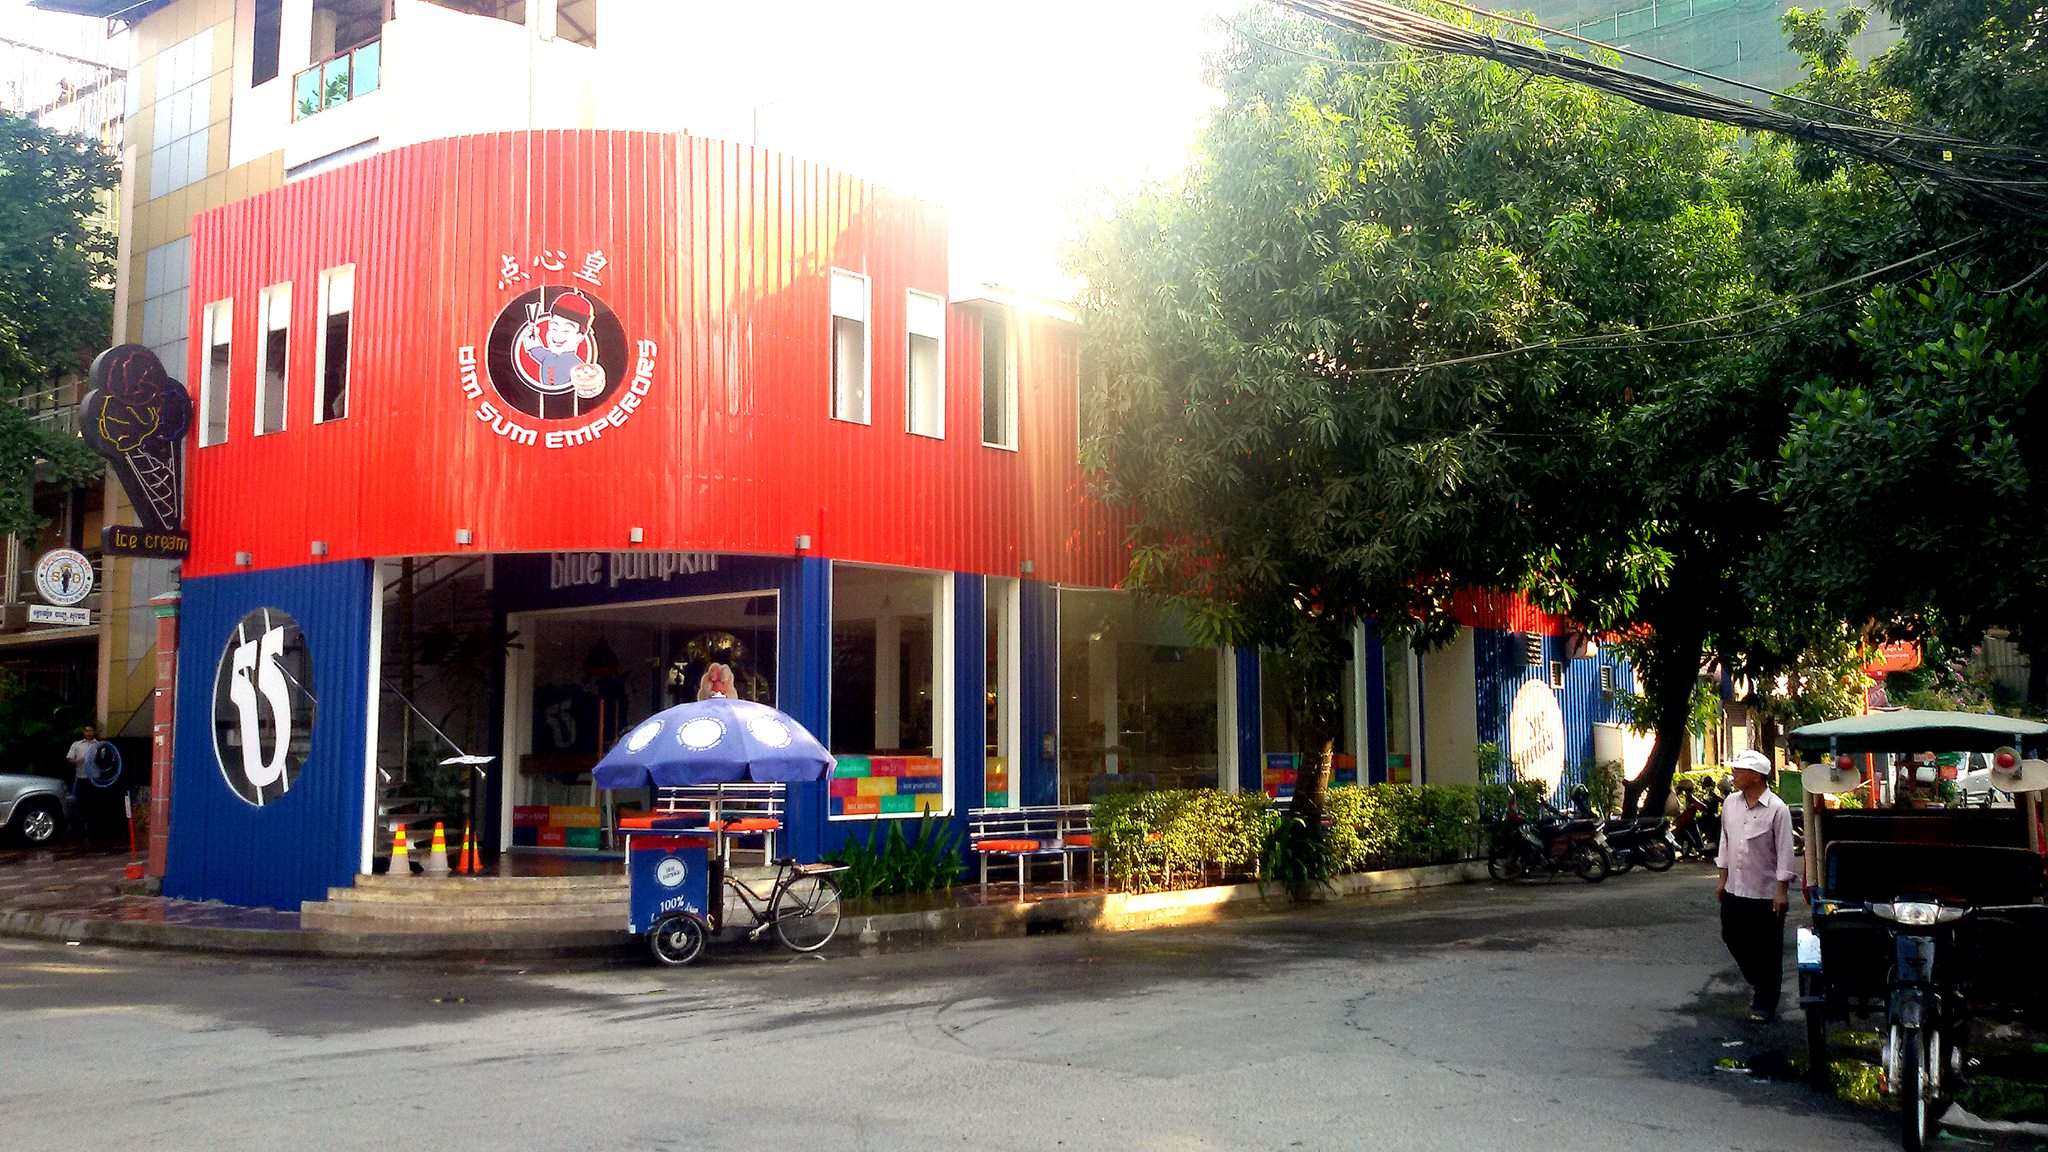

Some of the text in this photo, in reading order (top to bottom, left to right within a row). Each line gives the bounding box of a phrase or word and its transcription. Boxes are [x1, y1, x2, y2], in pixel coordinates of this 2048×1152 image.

[498, 249, 608, 290] 点心皇
[458, 338, 658, 449] DIM SUM EMPERORS
[115, 529, 189, 552] ice cream
[550, 552, 602, 590] blue
[660, 895, 685, 913] 100%
